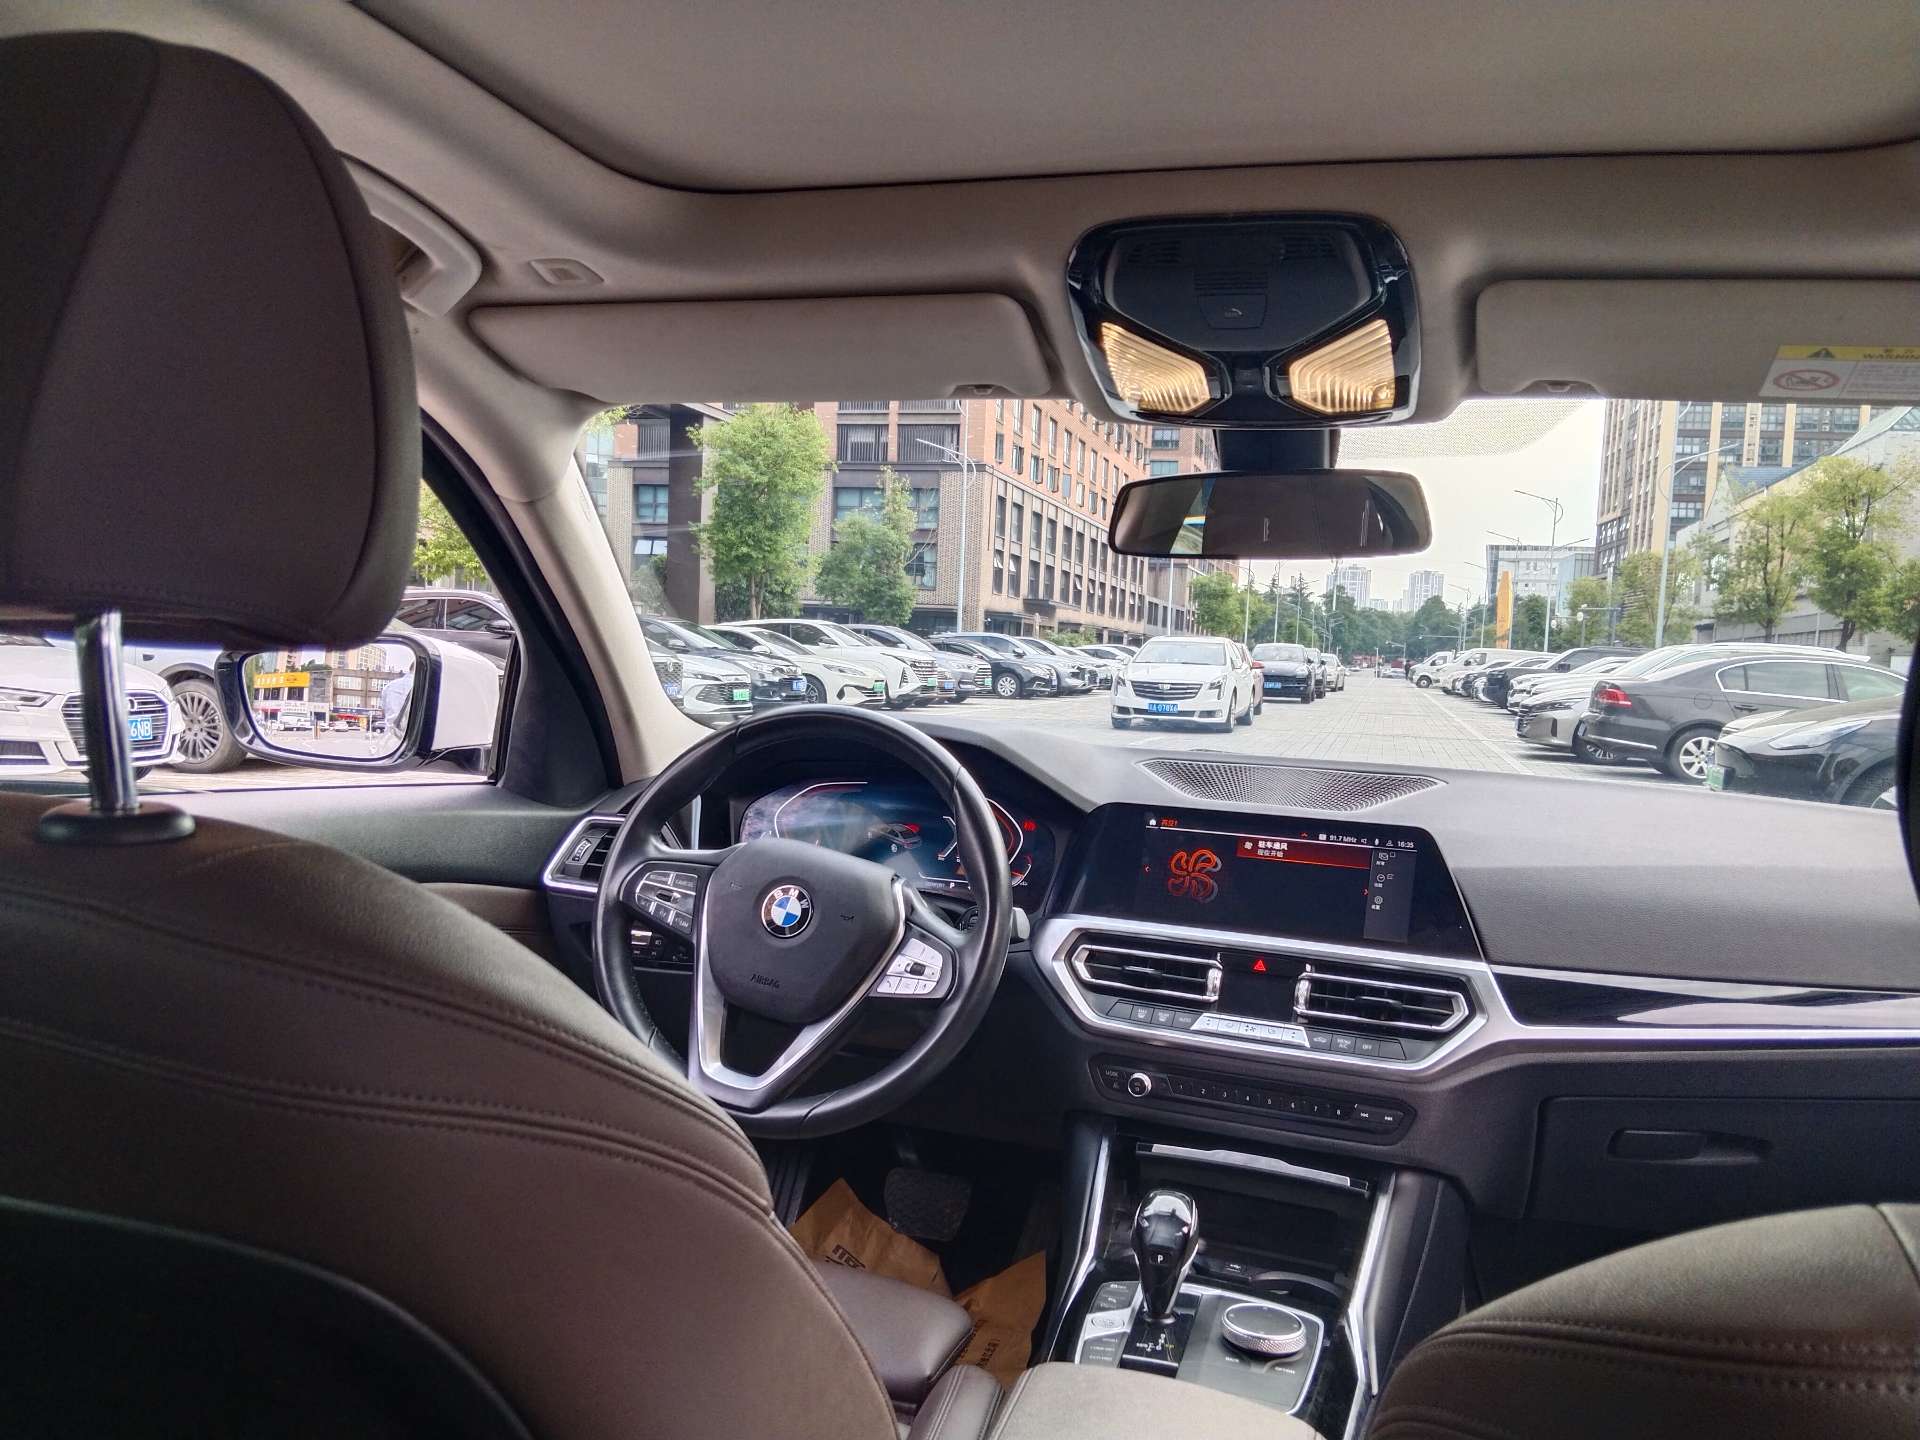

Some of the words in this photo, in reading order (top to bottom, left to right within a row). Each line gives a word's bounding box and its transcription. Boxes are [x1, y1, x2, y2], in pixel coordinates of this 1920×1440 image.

[1329, 834, 1343, 842] 91.7
[1343, 836, 1358, 844] MHz
[772, 888, 810, 909] BMW
[750, 973, 780, 988] AIRBAG
[1157, 1254, 1164, 1264] P
